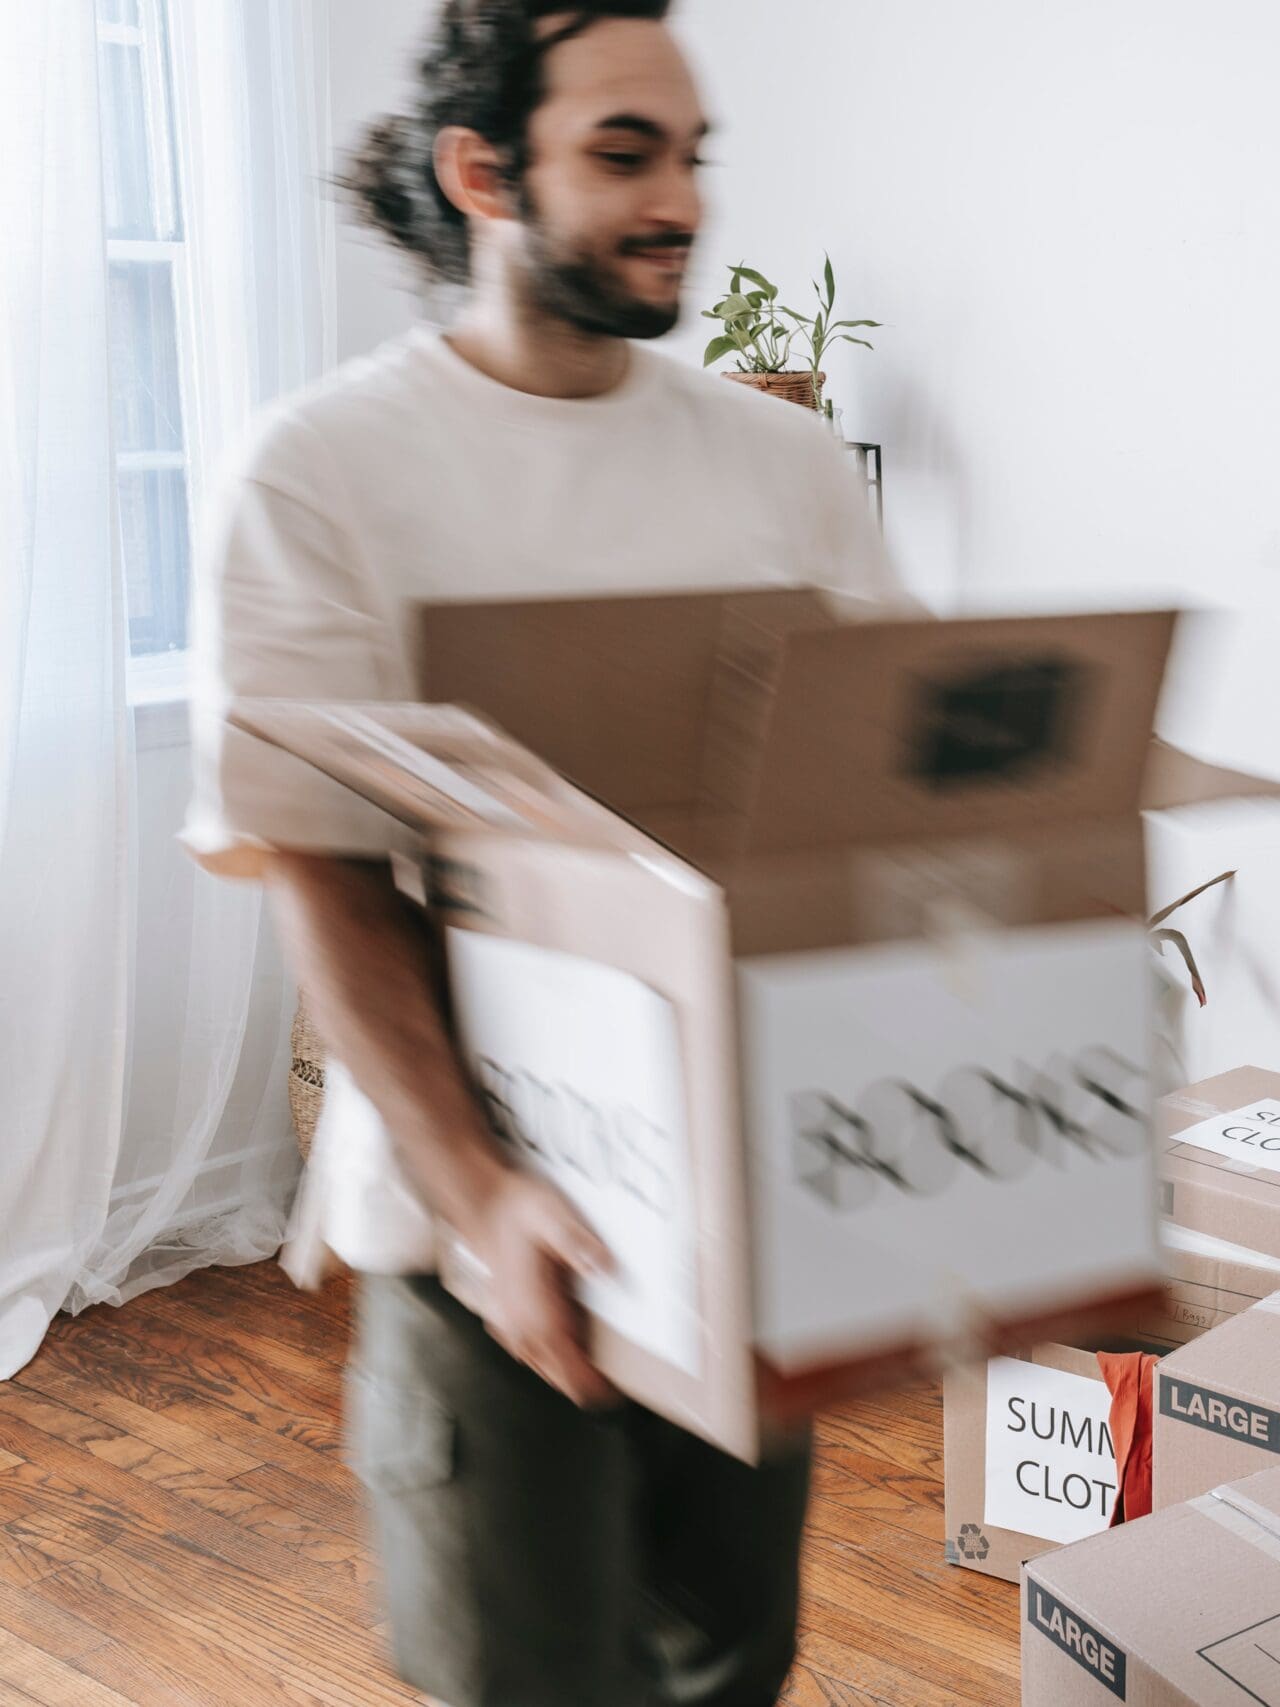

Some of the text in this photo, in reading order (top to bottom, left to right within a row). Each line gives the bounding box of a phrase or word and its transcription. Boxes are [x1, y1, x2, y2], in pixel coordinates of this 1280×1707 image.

[1007, 1396, 1116, 1459] SUMM
[1171, 1386, 1270, 1442] LARGE
[1016, 1460, 1116, 1516] CLOT
[1036, 1592, 1116, 1683] LARGE
